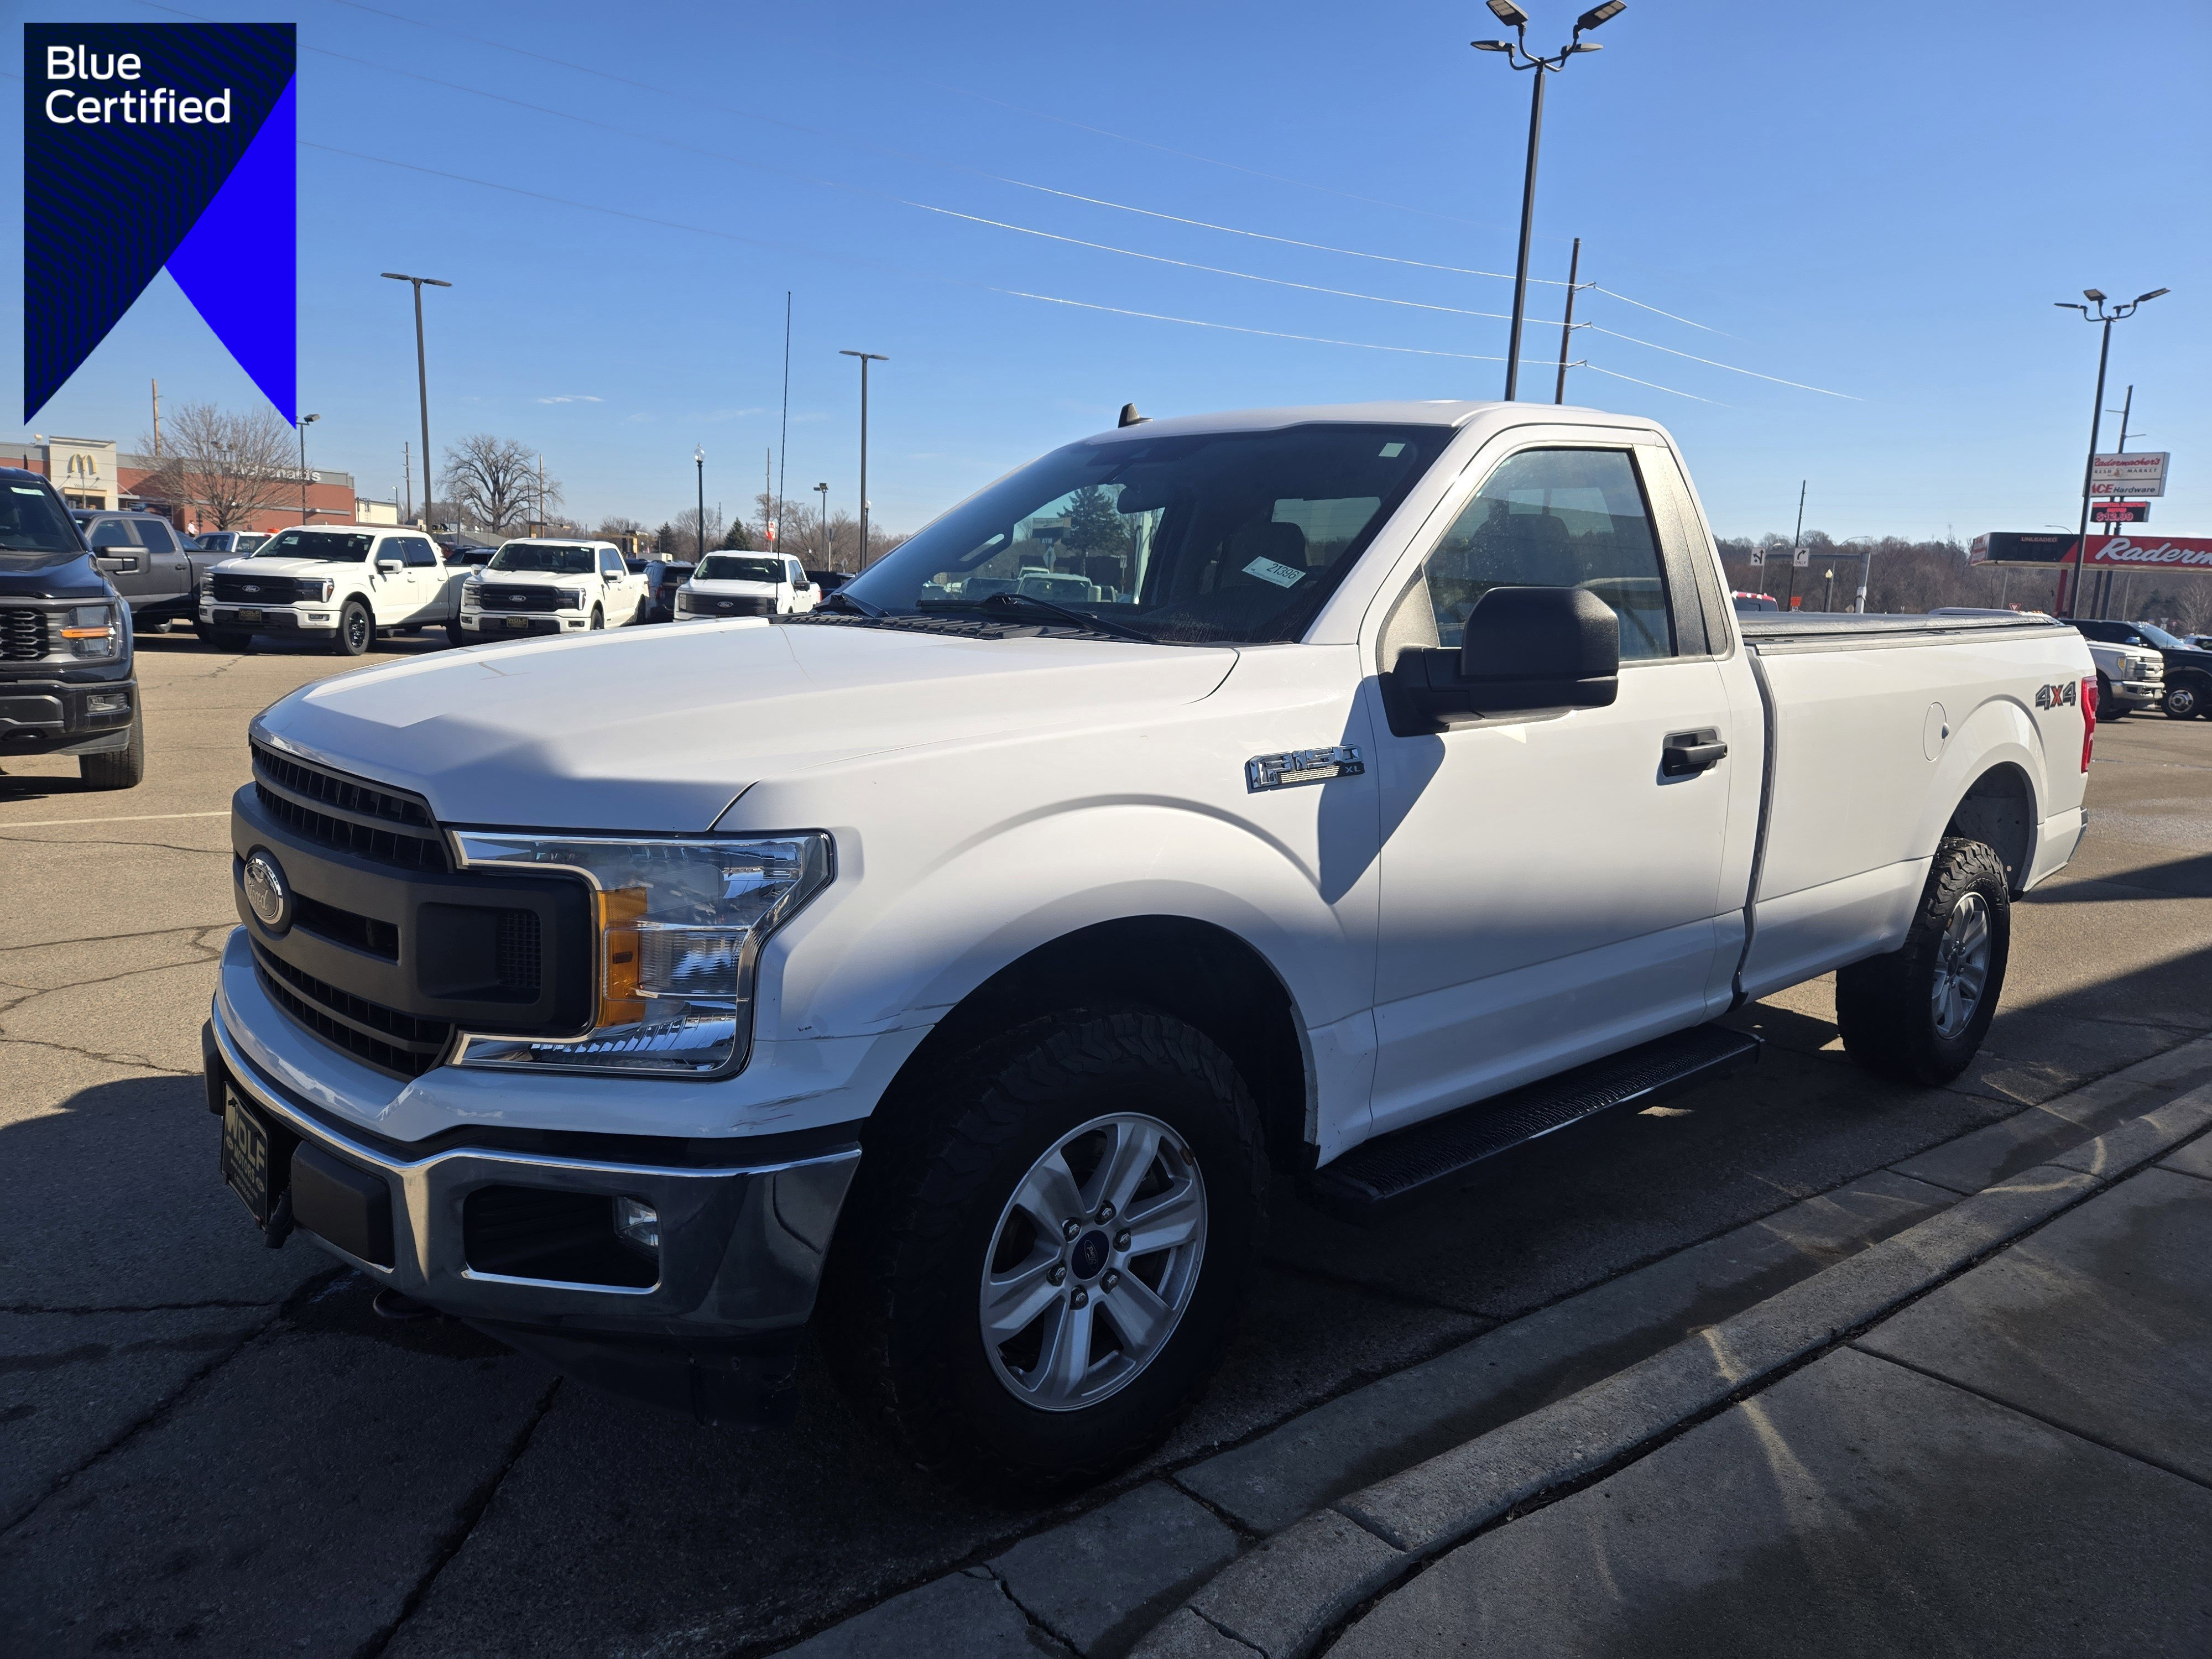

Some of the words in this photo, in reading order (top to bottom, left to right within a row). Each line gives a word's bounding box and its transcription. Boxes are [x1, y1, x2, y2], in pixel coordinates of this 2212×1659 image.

[2095, 457, 2161, 467] Radermacher's
[1266, 563, 1300, 580] 21396
[234, 1143, 255, 1184] MOTORS
